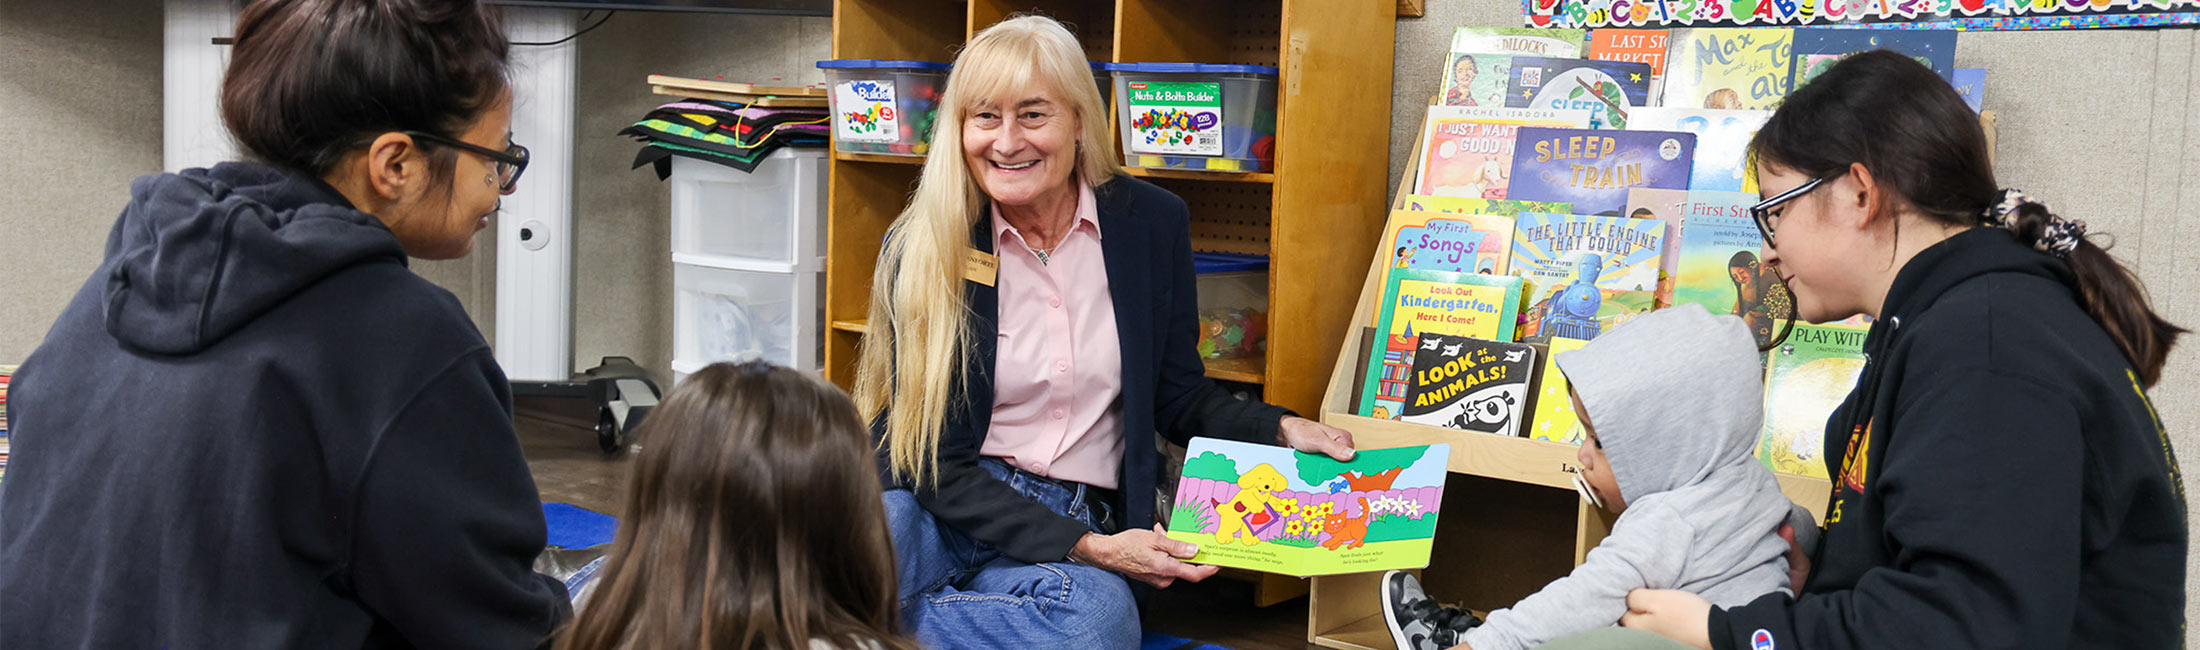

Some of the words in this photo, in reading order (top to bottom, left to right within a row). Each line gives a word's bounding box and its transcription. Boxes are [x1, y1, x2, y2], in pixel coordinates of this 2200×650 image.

[1611, 34, 1646, 48] LAST
[1693, 33, 1755, 86] Max
[1135, 91, 1154, 101] Nuts
[1155, 91, 1164, 101] &
[1165, 91, 1186, 101] Bolts
[1187, 91, 1214, 102] Builder
[1459, 108, 1500, 117] RACHEL
[1506, 109, 1556, 118] ISADORA
[1438, 123, 1443, 133] I
[1447, 123, 1478, 135] JUST
[1482, 124, 1518, 137] WANT
[1460, 138, 1501, 154] GOOD
[1534, 136, 1617, 163] SLEEP
[1569, 163, 1643, 189] TRAIN
[1693, 202, 1724, 217] First
[1427, 223, 1442, 234] My
[1444, 223, 1469, 233] First
[1527, 224, 1551, 242] THE
[1557, 222, 1602, 237] LITTLE
[1608, 225, 1658, 251] ENGINE
[1419, 233, 1475, 263] Songs
[1549, 235, 1582, 251] THAT
[1588, 235, 1633, 257] COULD
[1430, 285, 1452, 296] Look
[1455, 287, 1473, 297] Out
[1416, 312, 1437, 322] Here
[1440, 312, 1444, 322] I
[1446, 313, 1476, 325] Come!
[1795, 328, 1832, 344] PLAY
[1477, 347, 1488, 357] at
[1480, 355, 1497, 364] the
[1417, 351, 1477, 387] LOOK
[1414, 365, 1507, 407] ANIMALS!
